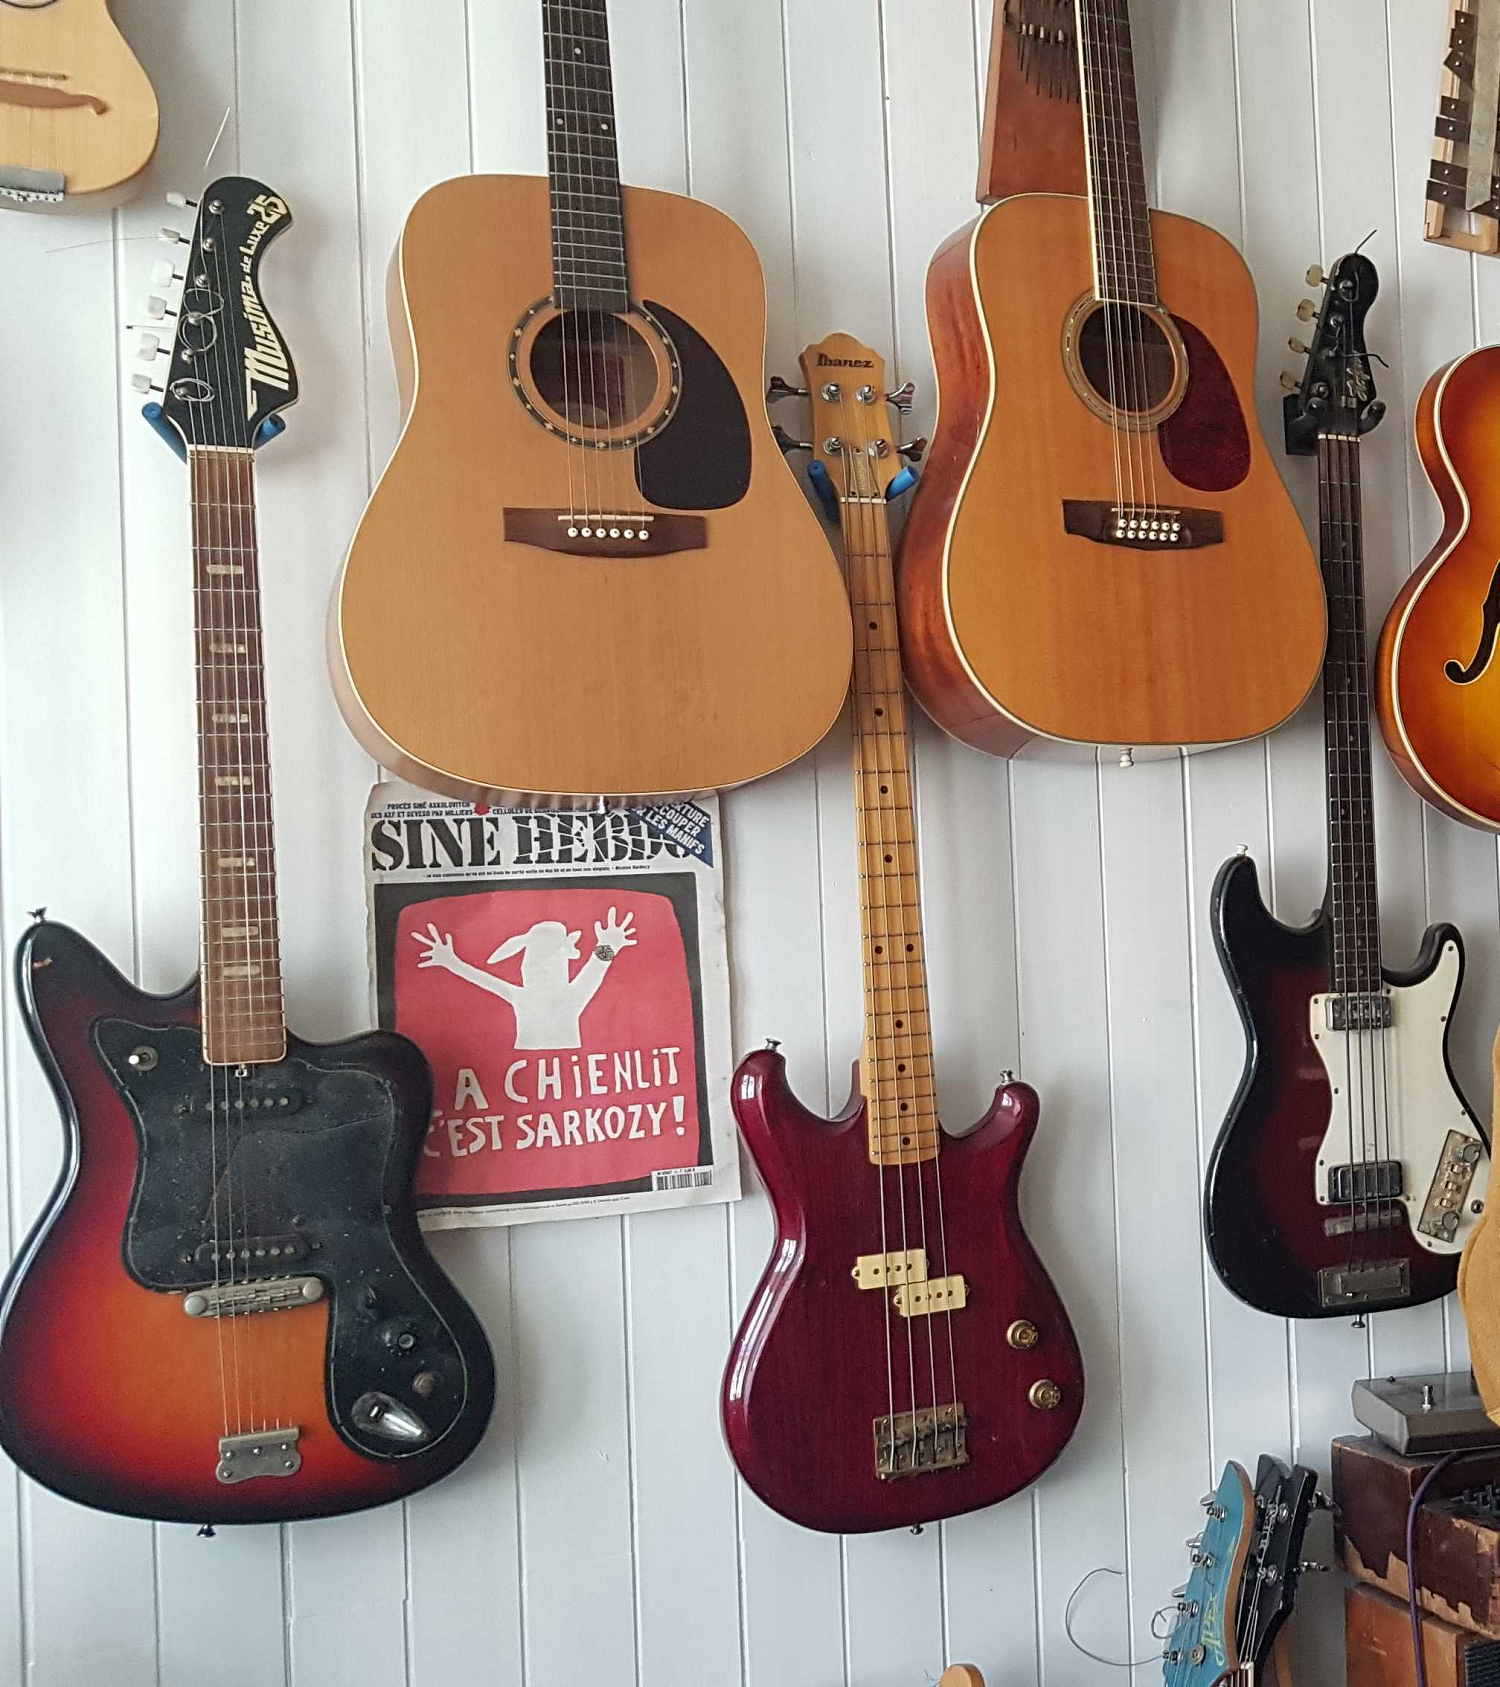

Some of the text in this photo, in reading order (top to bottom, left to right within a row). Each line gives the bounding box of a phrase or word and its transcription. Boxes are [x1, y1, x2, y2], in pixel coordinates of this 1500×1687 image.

[246, 194, 288, 225] 25
[239, 221, 270, 256] Luxe
[240, 258, 252, 274] de
[816, 353, 874, 369] Ibanez
[645, 810, 668, 830] LES
[665, 824, 705, 855] MANIFS
